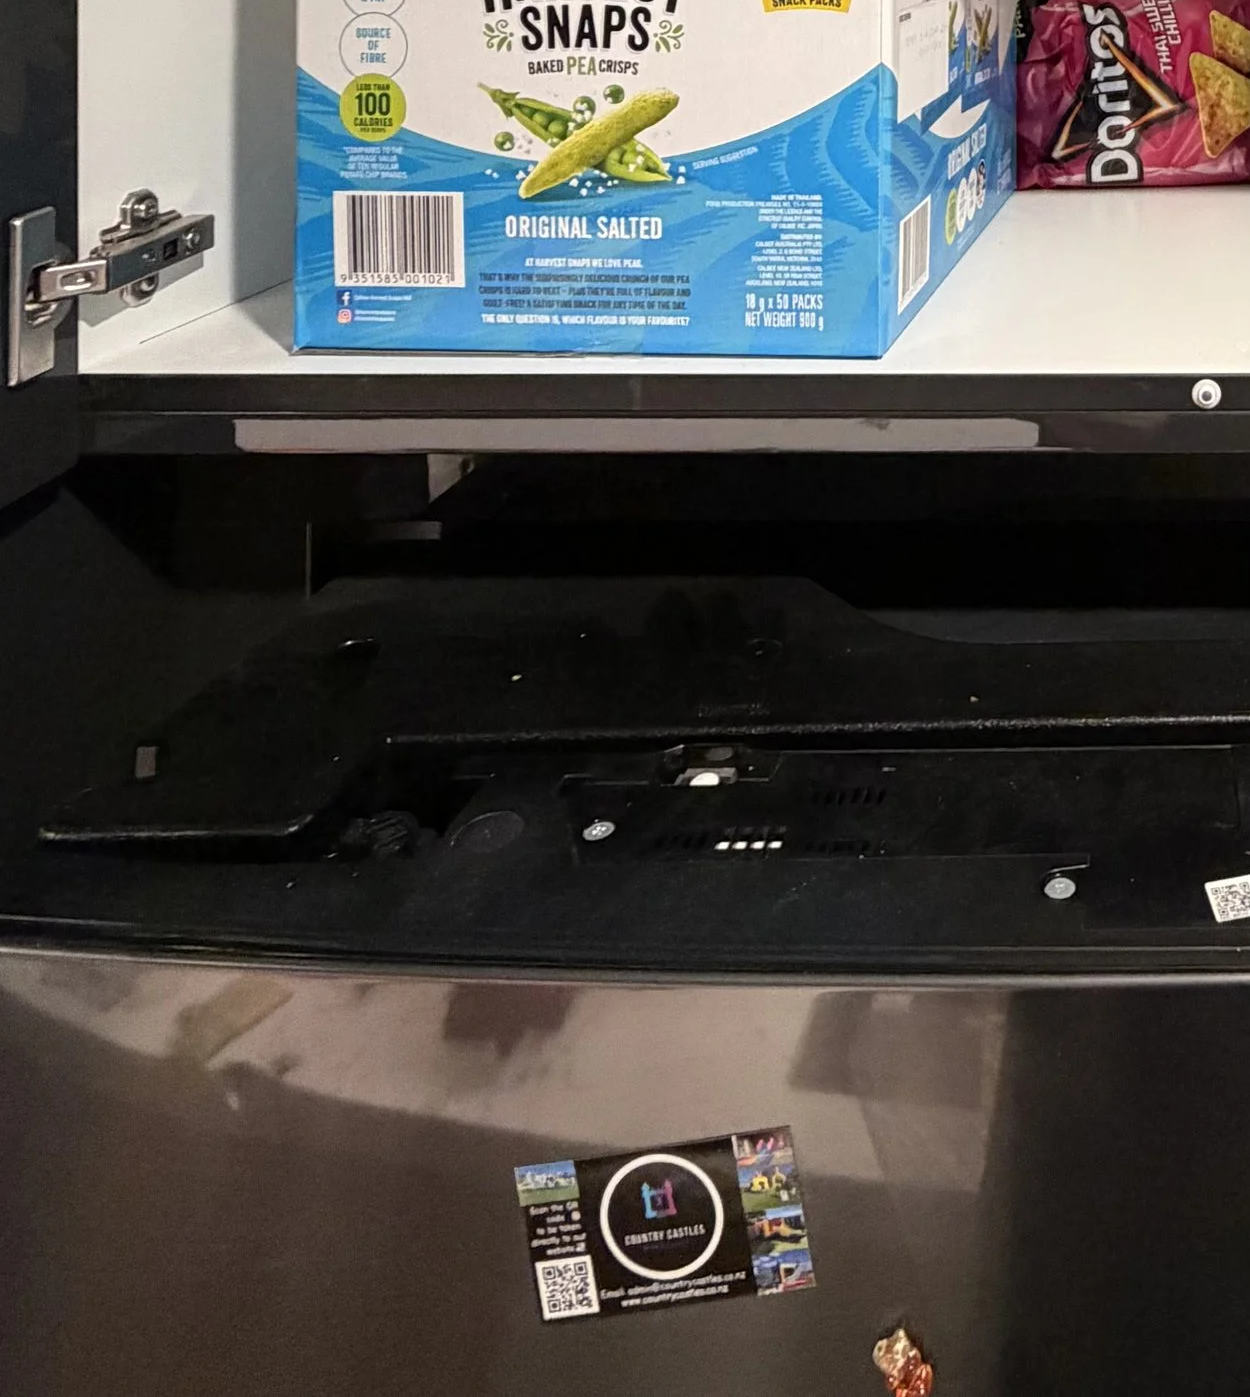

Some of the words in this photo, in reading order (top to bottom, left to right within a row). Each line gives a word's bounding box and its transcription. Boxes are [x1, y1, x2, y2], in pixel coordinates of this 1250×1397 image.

[355, 28, 391, 38] SOURCE
[520, 4, 652, 52] SNAPS
[367, 40, 379, 51] OF
[1154, 35, 1173, 74] THAI
[360, 52, 387, 63] FIBRE
[528, 59, 564, 75] BAKED
[566, 56, 597, 76] PEA
[598, 59, 640, 75] CRISPS
[1082, 3, 1140, 183] Doritos
[355, 92, 391, 116] 100
[353, 117, 393, 127] CALORIES
[505, 215, 593, 240] ORIGINAL
[597, 216, 662, 240] SALTED
[340, 274, 347, 283] 9
[353, 274, 399, 284] 351585
[405, 274, 450, 284] 001021
[745, 293, 756, 309] 18
[758, 297, 765, 313] g
[767, 297, 774, 309] x
[776, 293, 789, 309] 50
[791, 293, 824, 310] PACKS
[745, 311, 760, 327] NET
[763, 311, 797, 328] WEIGHT
[799, 312, 816, 328] 900
[818, 316, 824, 331] g
[624, 1230, 665, 1246] COUNTRY
[666, 1223, 706, 1240] CASTLES
